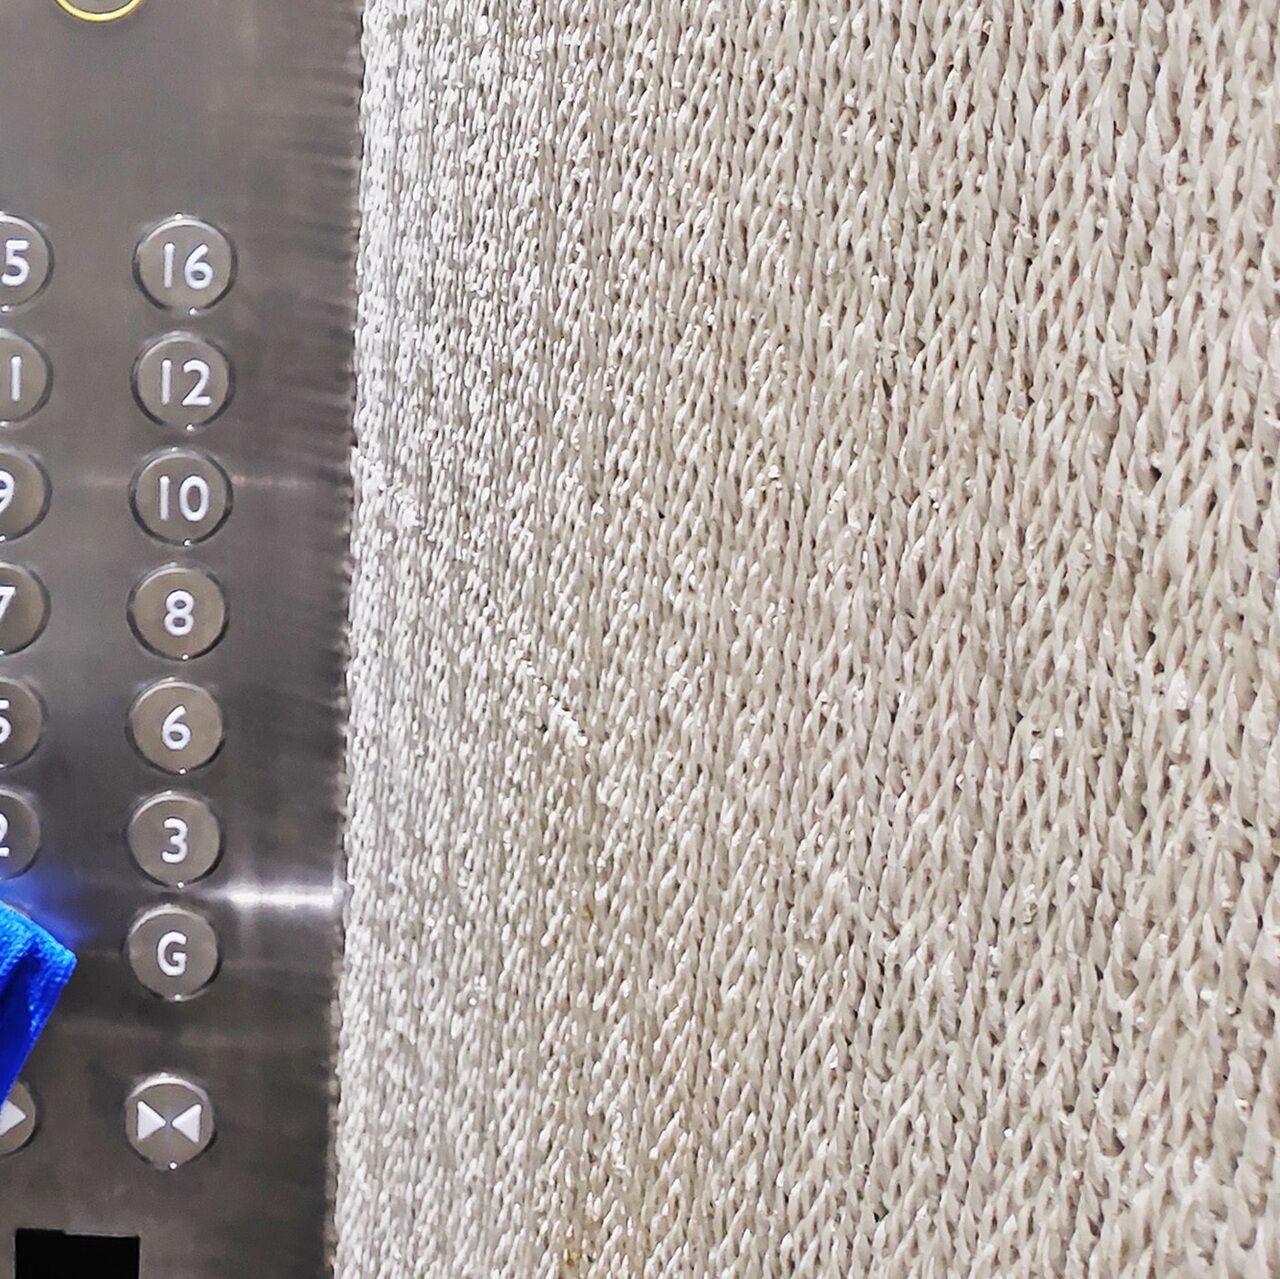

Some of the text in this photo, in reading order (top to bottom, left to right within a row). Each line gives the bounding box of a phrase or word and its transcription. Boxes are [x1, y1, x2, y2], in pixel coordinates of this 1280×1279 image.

[164, 243, 213, 290] 16
[161, 359, 212, 406] 12
[159, 475, 210, 522] 10
[164, 590, 195, 636] 8
[162, 705, 191, 750] 6
[162, 818, 188, 863] 3
[157, 931, 187, 976] G
